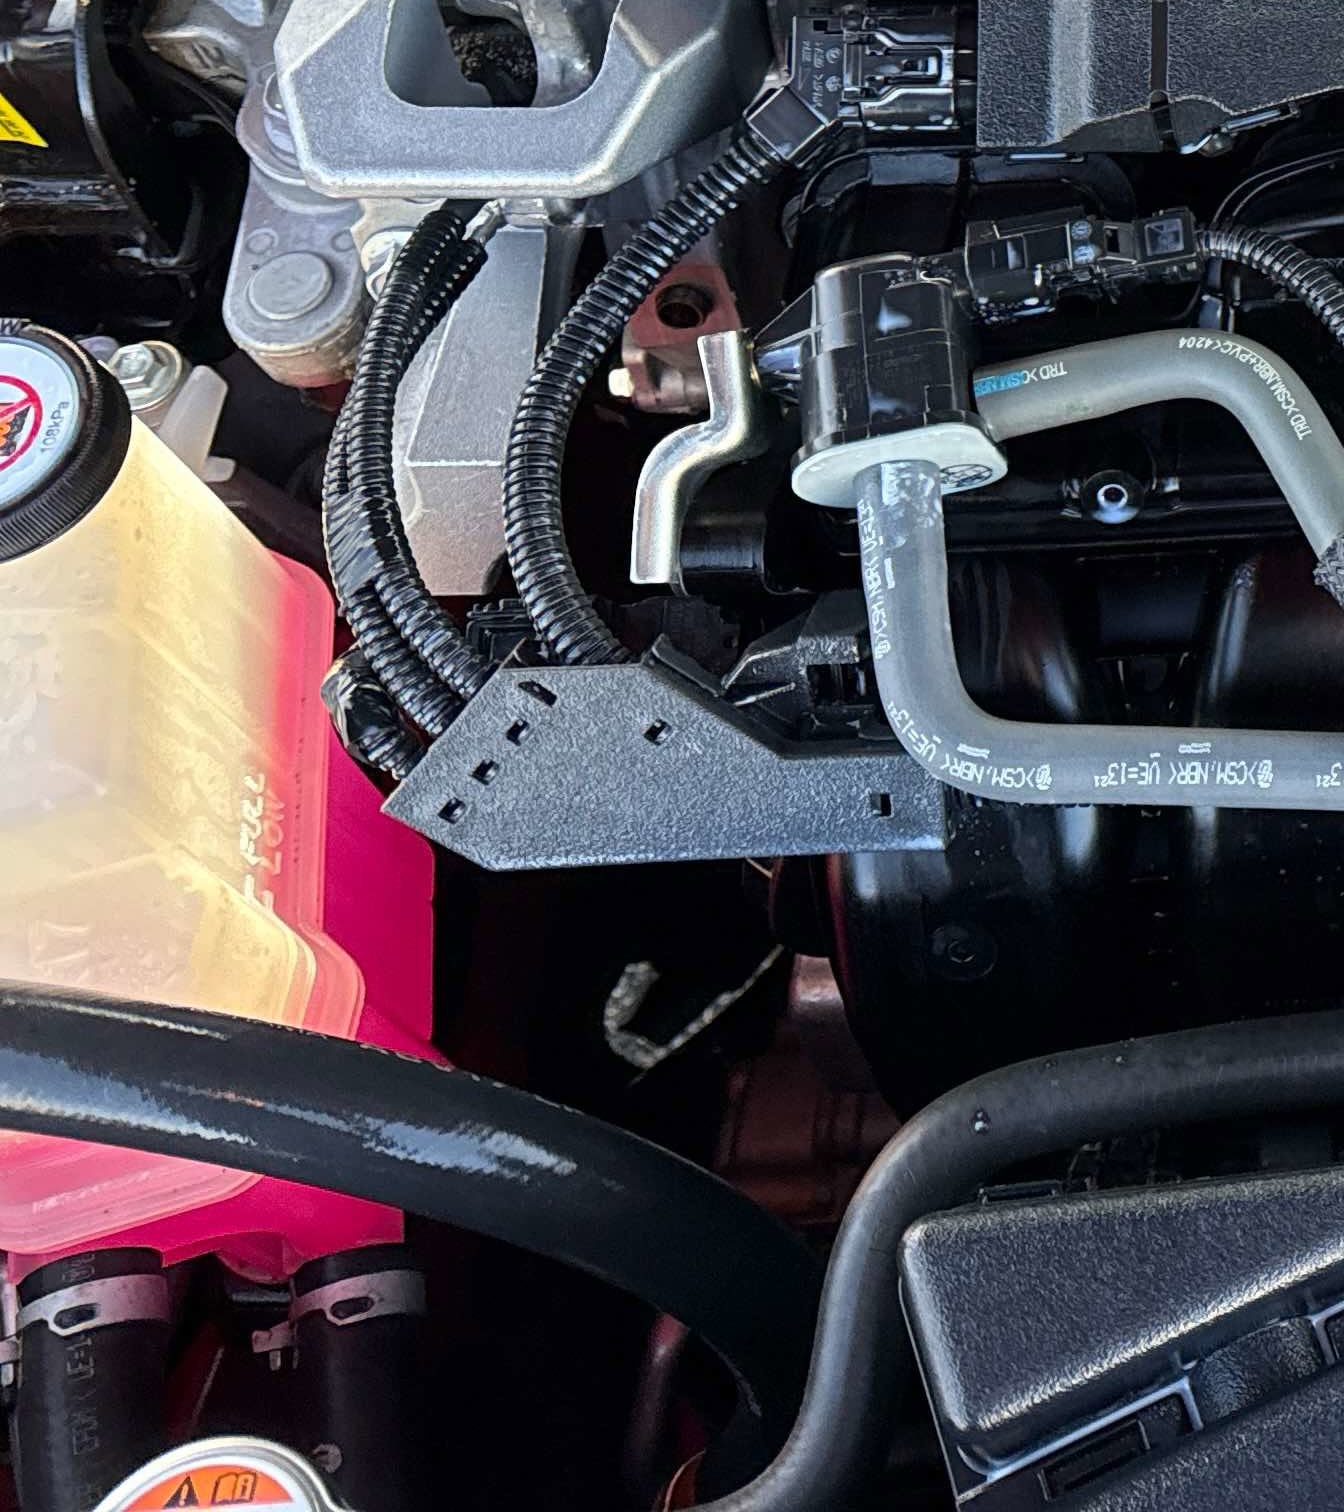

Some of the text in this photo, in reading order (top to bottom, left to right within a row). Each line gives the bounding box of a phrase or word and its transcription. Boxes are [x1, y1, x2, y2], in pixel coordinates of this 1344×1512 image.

[1039, 361, 1068, 381] TRD
[40, 400, 71, 453] 108kPa
[1290, 415, 1313, 440] TRD
